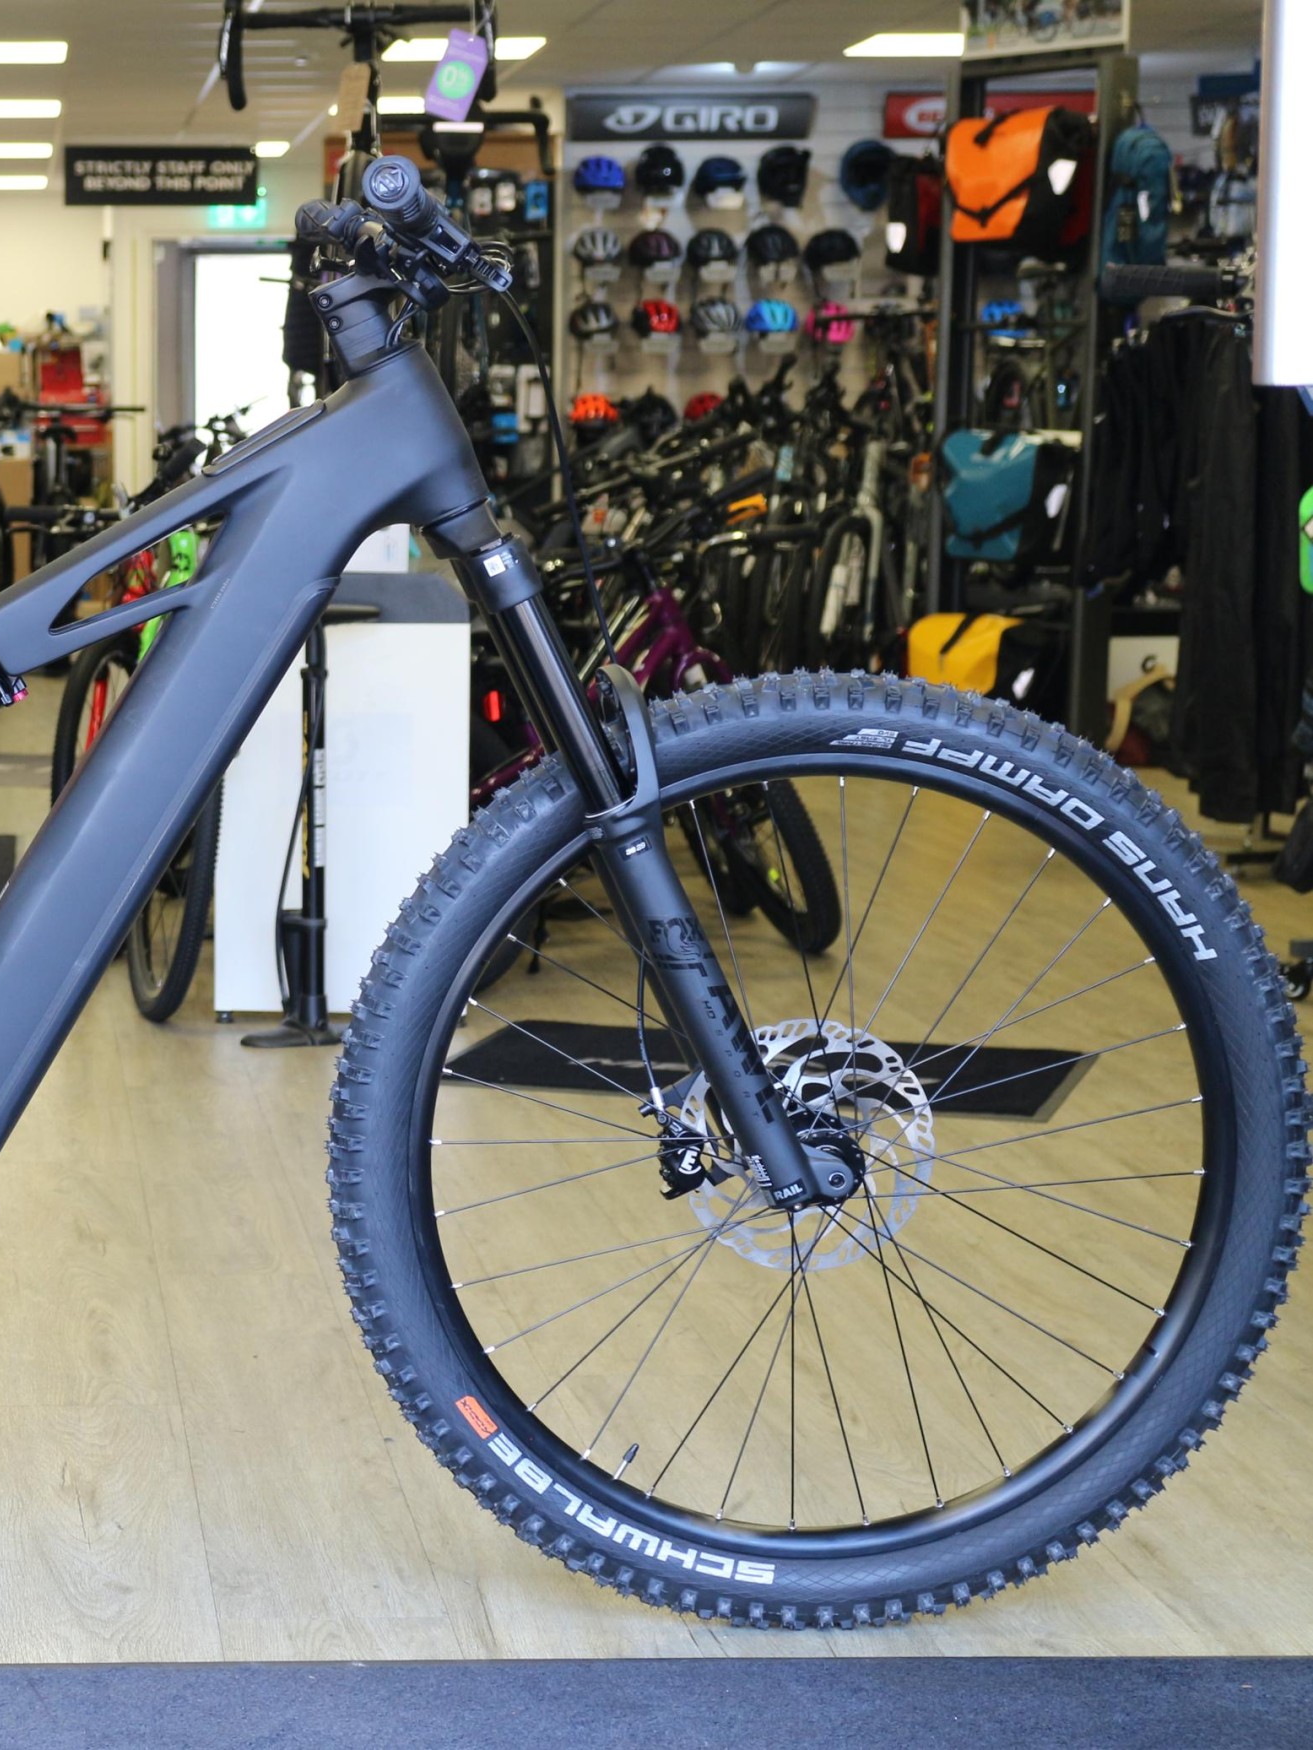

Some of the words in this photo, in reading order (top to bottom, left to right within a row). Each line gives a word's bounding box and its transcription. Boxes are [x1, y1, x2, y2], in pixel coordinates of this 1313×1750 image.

[662, 104, 779, 132] GIRO
[73, 160, 152, 176] STRICTLY
[155, 160, 206, 175] STAFF
[209, 160, 256, 176] ONLY
[83, 176, 151, 192] BEYOND
[155, 176, 192, 191] THIS
[194, 176, 246, 191] POINT
[901, 738, 1106, 831] DAMPF
[1103, 830, 1218, 962] HANS
[774, 1182, 803, 1201] RAIL
[488, 1432, 776, 1585] SCHWALBE
